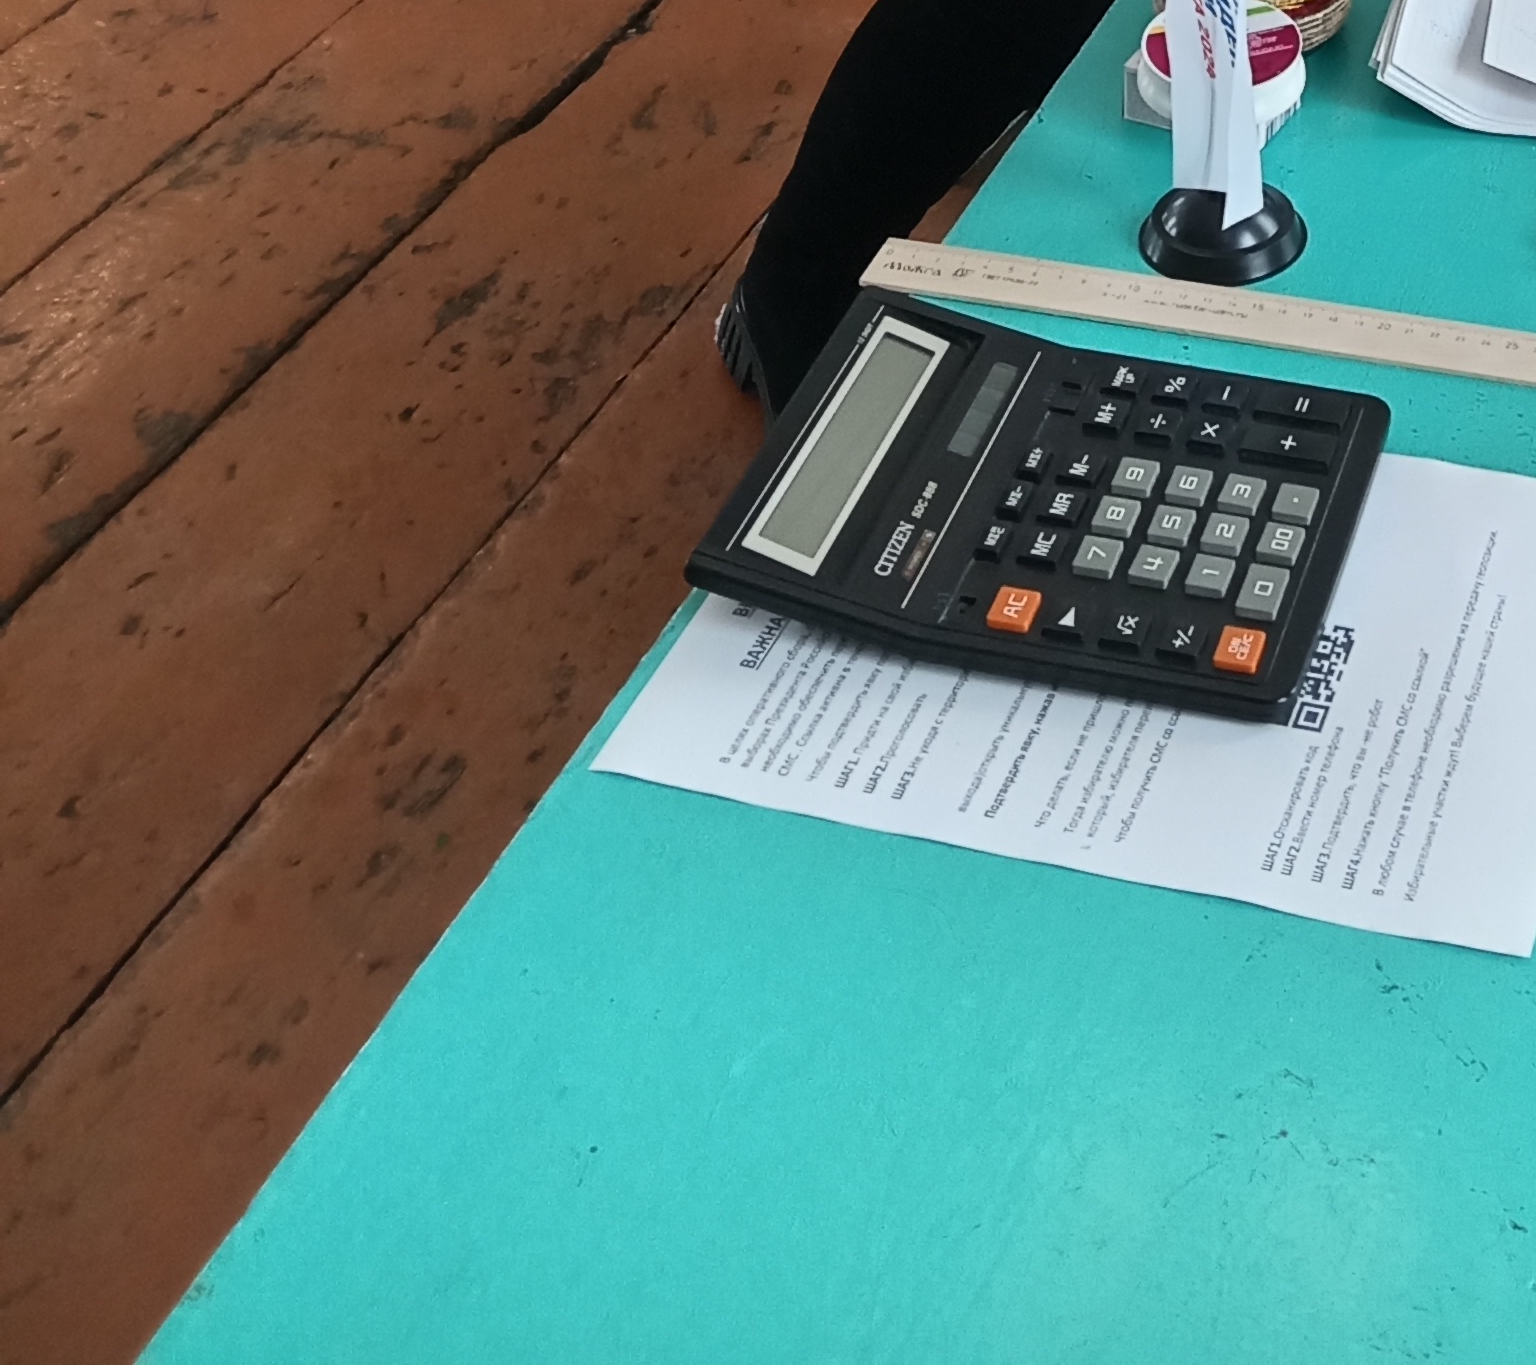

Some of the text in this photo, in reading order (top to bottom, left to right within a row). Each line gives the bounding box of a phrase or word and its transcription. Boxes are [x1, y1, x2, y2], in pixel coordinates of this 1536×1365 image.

[1198, 19, 1216, 80] 2024
[1002, 588, 1027, 618] AC
[1030, 531, 1056, 556] MC
[1048, 492, 1074, 515] MR
[1094, 402, 1116, 423] M+
[1086, 466, 1144, 559] 7 8 9
[1142, 474, 1198, 570] 4 5 6
[1215, 523, 1235, 538] 2
[1231, 483, 1251, 498] 3
[1270, 527, 1293, 550] 00
[873, 520, 914, 576] CITIZEN
[739, 617, 782, 668] ВАЖНА
[1367, 698, 1382, 728] робот
[1450, 704, 1473, 747] Выберем
[983, 693, 1055, 818] Подтвердить явку, нажав
[1350, 763, 1361, 779] что
[1355, 747, 1366, 761] вы
[1280, 726, 1343, 875] ШАГ2.Ввести номер телефона
[1341, 819, 1374, 889] ШАГ4.Нажать
[1369, 781, 1389, 817] кнопку
[1395, 704, 1412, 726] СМС
[1406, 692, 1416, 703] со
[1378, 850, 1396, 887] любом
[1389, 813, 1408, 848] случае
[1404, 755, 1427, 802] телефоне
[1421, 693, 1446, 753] необходимо
